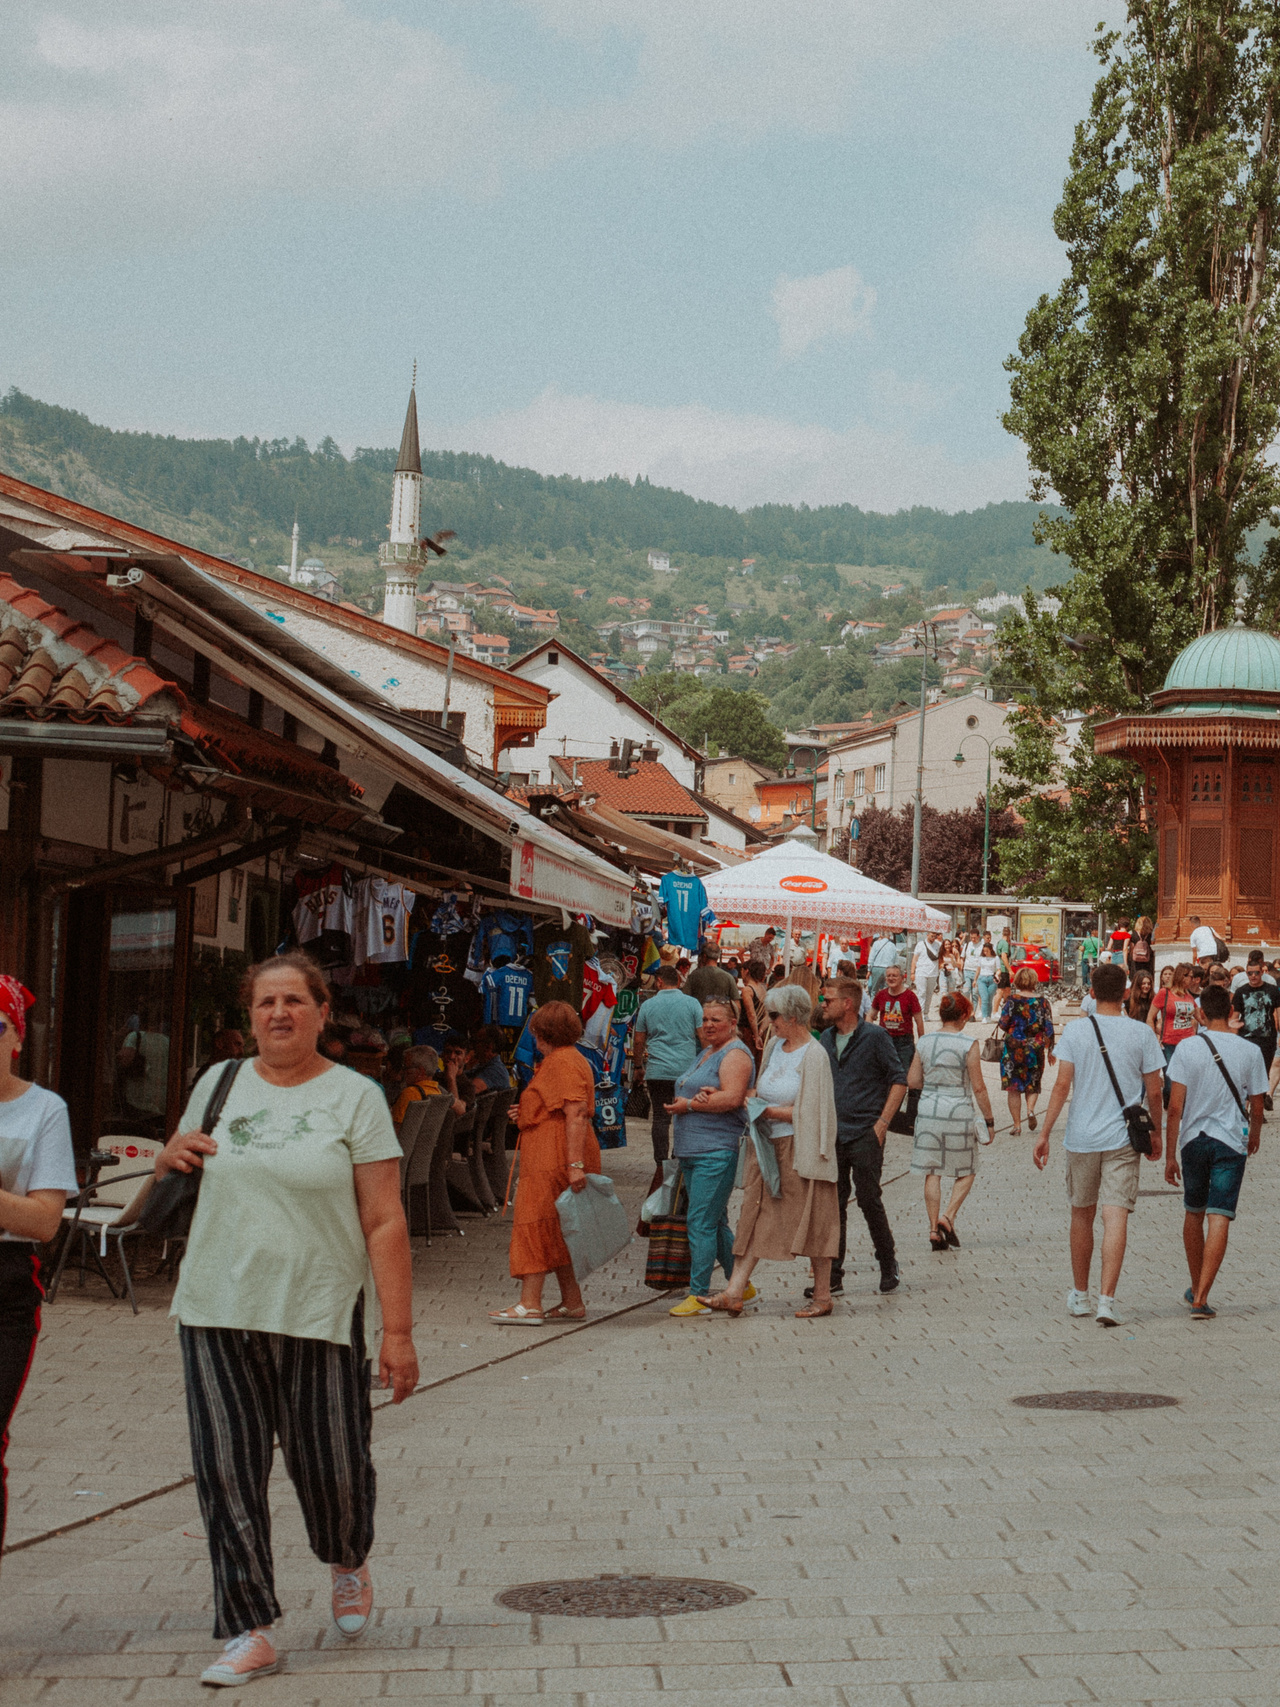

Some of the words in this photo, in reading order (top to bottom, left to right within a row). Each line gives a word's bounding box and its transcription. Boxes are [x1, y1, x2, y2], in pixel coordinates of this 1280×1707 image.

[781, 880, 825, 889] Coca-Cola
[676, 889, 689, 912] 11
[382, 914, 396, 946] 6
[583, 978, 602, 993] NALDO
[508, 986, 525, 1017] 11
[601, 1105, 616, 1126] 9
